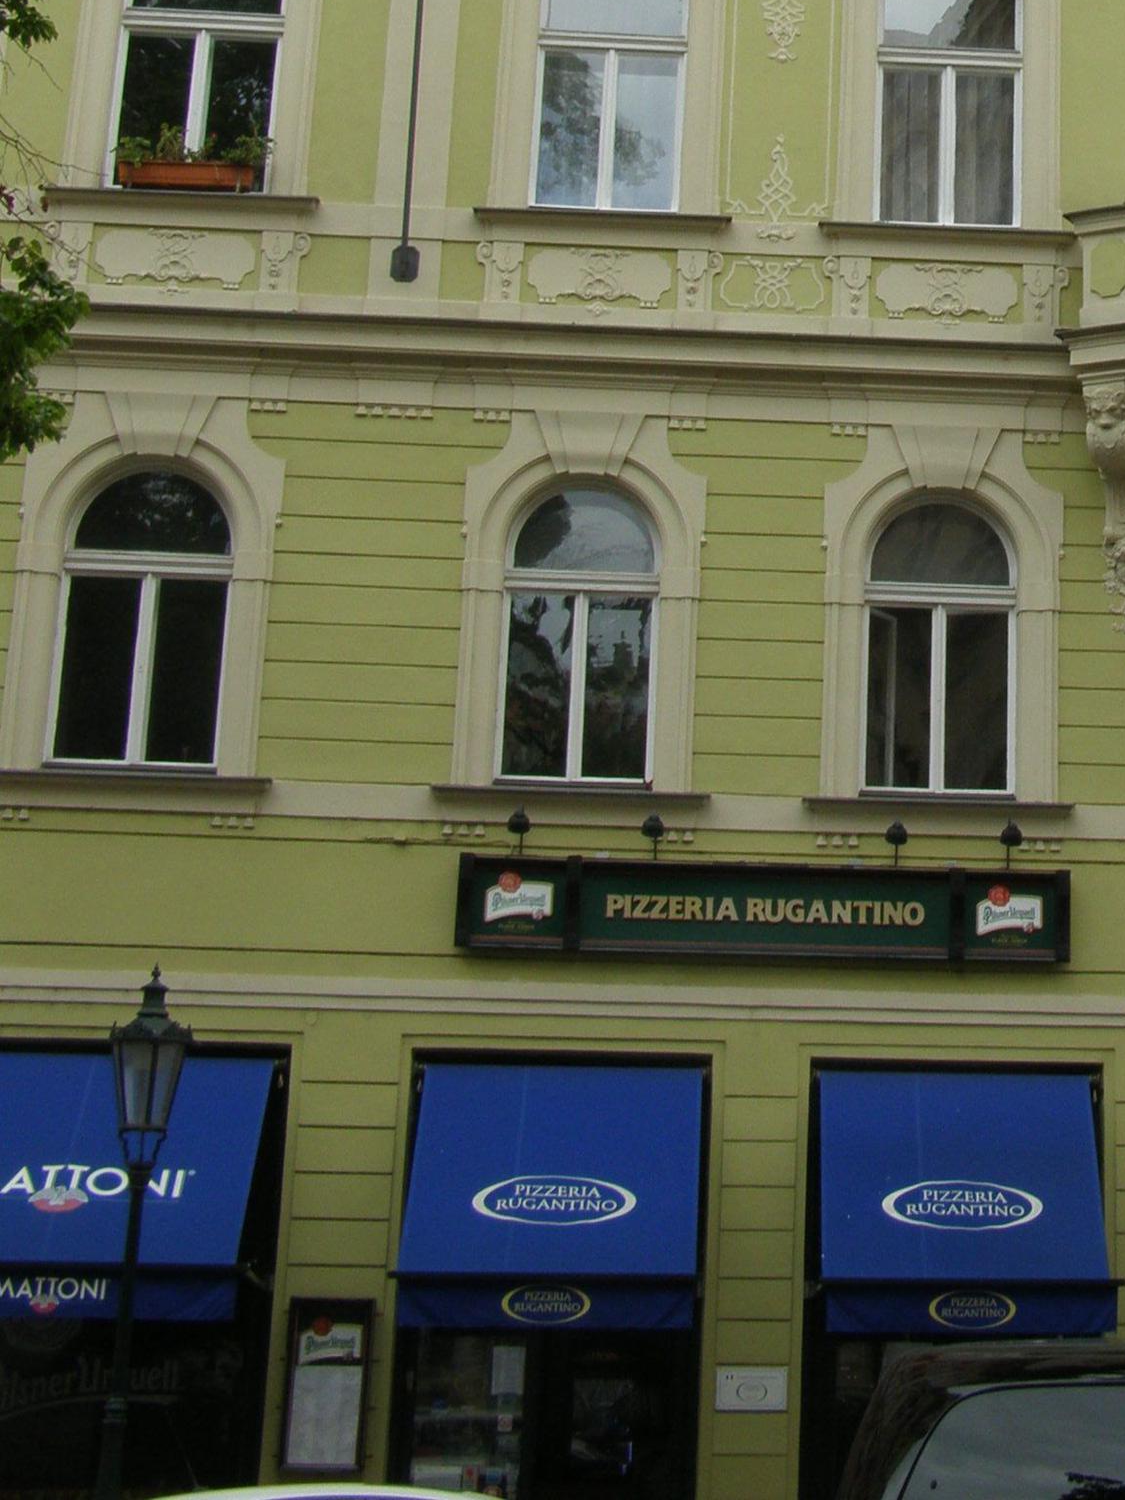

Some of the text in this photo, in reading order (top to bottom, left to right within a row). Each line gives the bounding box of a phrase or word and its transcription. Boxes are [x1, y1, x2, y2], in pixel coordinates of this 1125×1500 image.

[605, 894, 926, 926] PIZZERIA RUGANTINO
[515, 1184, 601, 1198] PIZZERIA
[922, 1189, 1008, 1204] PIZZERIA
[496, 1198, 618, 1212] RUGANTINO
[906, 1203, 1025, 1217] RUGANTINO
[0, 1277, 107, 1300] MATTONI
[524, 1291, 571, 1301] PIZZERIA
[951, 1298, 997, 1308] PIZZERIA
[514, 1302, 580, 1313] RUGANTINO
[941, 1308, 1007, 1318] RUGANTINO
